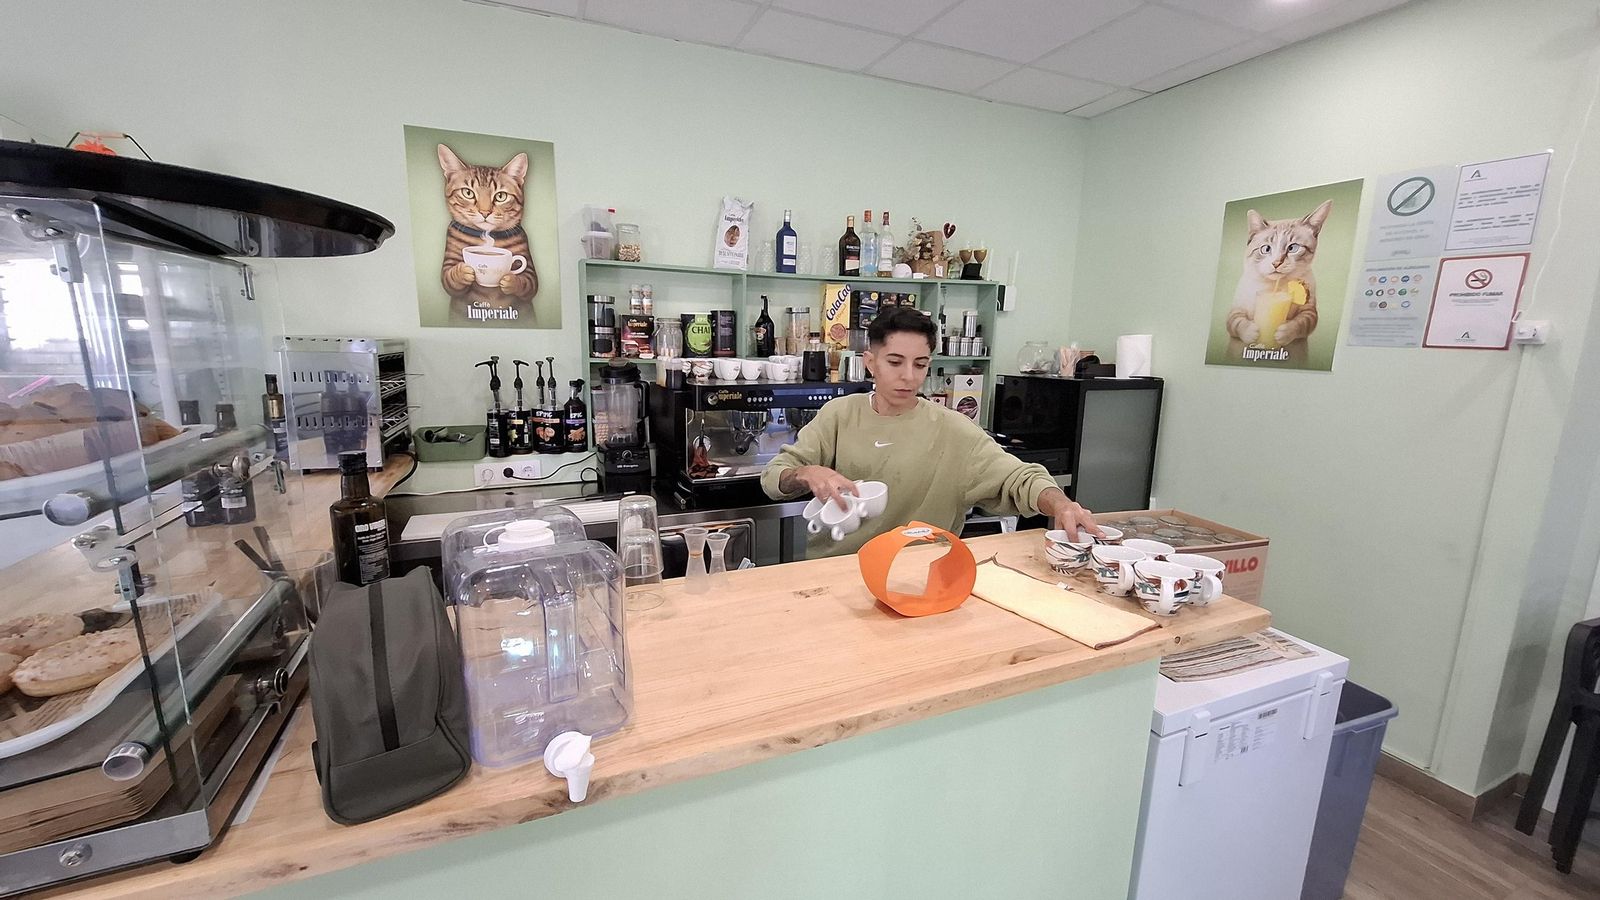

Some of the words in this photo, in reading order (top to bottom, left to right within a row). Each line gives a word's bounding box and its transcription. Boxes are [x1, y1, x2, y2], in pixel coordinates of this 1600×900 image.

[826, 283, 851, 321] ColaCao
[467, 304, 519, 322] Imperiale
[1242, 346, 1289, 362] Imperiale
